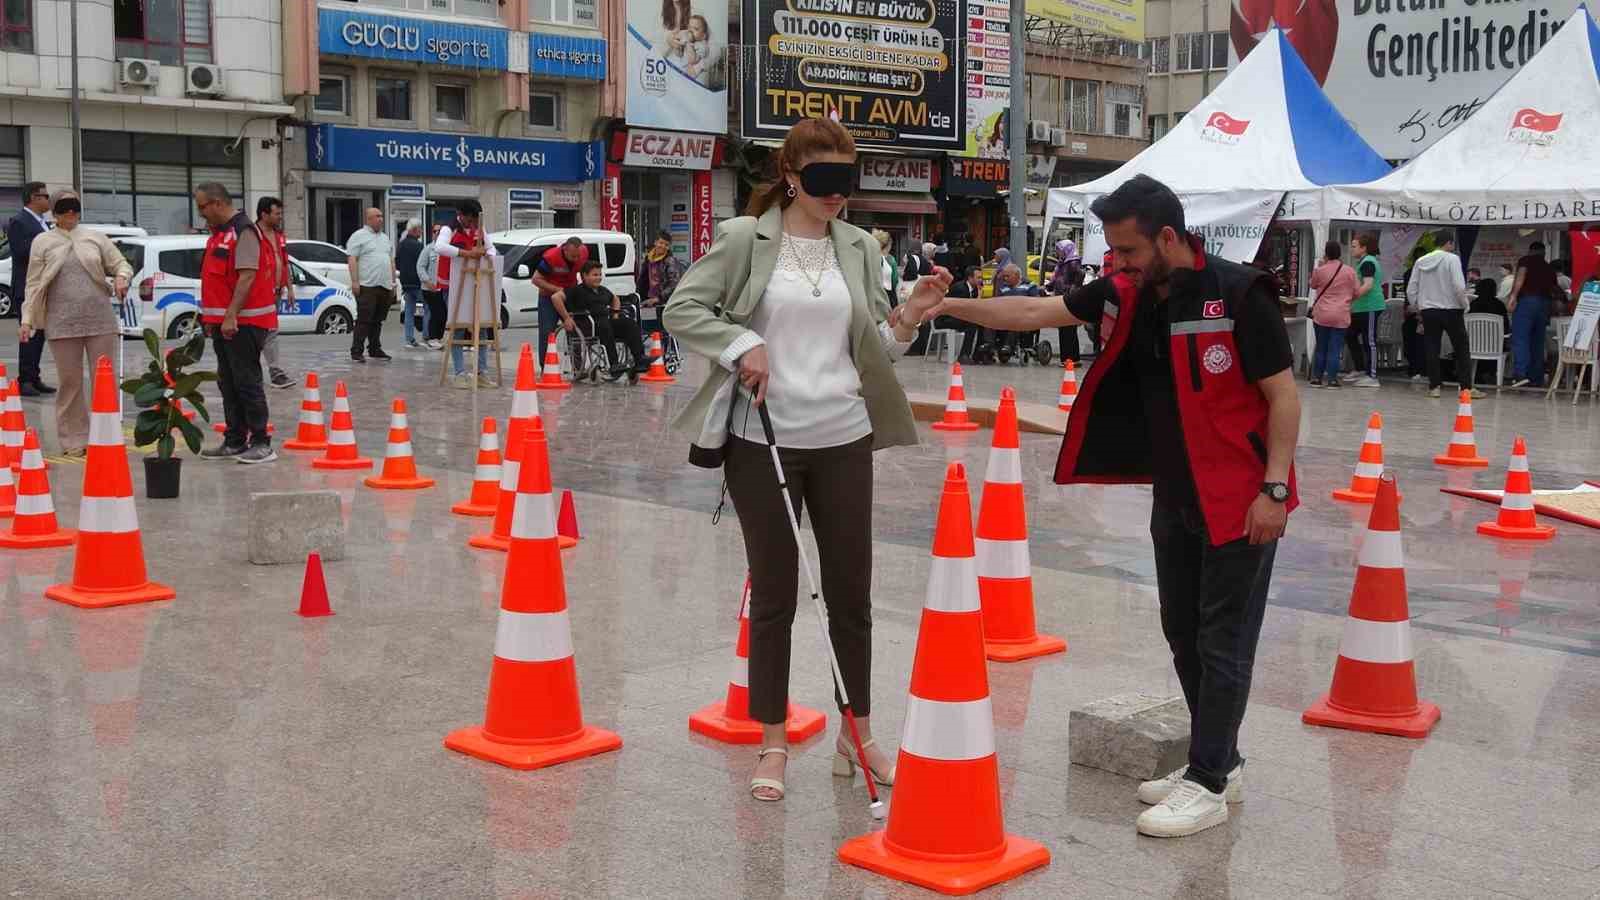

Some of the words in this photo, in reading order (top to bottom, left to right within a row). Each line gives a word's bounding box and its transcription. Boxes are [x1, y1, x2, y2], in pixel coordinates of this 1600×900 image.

[856, 2, 876, 16] EN
[878, 1, 927, 21] BÜYÜK
[342, 21, 419, 51] GÜÇLÜ
[782, 16, 842, 39] 111.000
[845, 27, 880, 43] ÇEŞİT
[883, 29, 917, 46] ÜRÜN
[921, 33, 940, 49] İLE
[537, 47, 566, 62] ethica
[777, 40, 826, 56] EVİNİZİN
[829, 46, 864, 61] EKSİĞİ
[866, 49, 903, 64] BİTENE
[905, 54, 941, 68] KADAR
[646, 59, 667, 76] 50
[805, 65, 867, 82] ARADIĞINIZ
[868, 70, 890, 84] HER
[767, 89, 862, 122] TRENT
[375, 140, 452, 161] TÜRKİYE
[473, 149, 546, 166] BANKASI
[629, 135, 712, 158] ECZANE
[863, 158, 930, 180] ECZANE
[962, 160, 1010, 182] TREN
[1346, 199, 1410, 220] KİLİS
[1418, 201, 1440, 221] İL
[1449, 202, 1513, 222] ÖZEL
